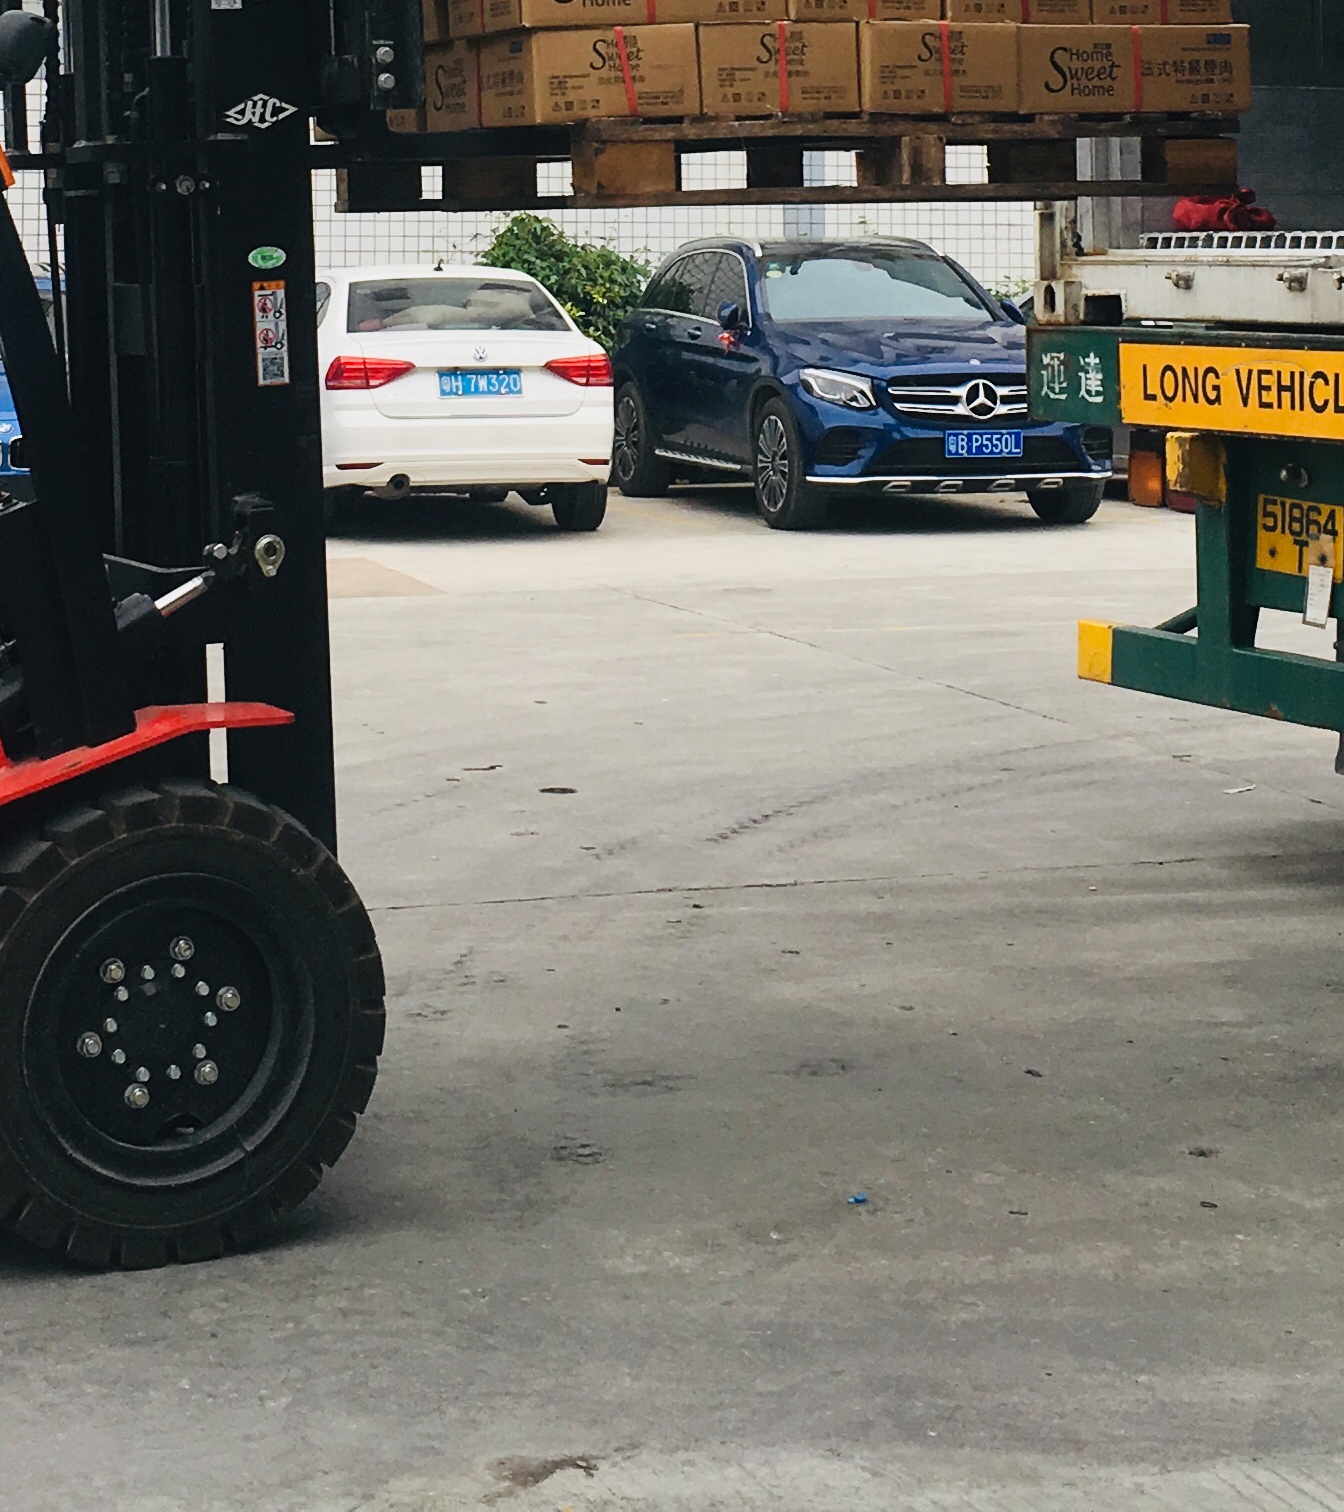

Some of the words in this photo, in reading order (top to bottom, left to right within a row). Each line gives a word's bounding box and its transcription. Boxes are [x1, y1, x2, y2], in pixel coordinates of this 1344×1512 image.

[1044, 46, 1121, 93] Sweet
[1069, 47, 1113, 62] Home
[1070, 82, 1114, 97] Home
[1040, 352, 1105, 404] 運達
[1142, 363, 1223, 406] LONG
[1262, 496, 1339, 540] 51864
[1293, 538, 1309, 575] T
